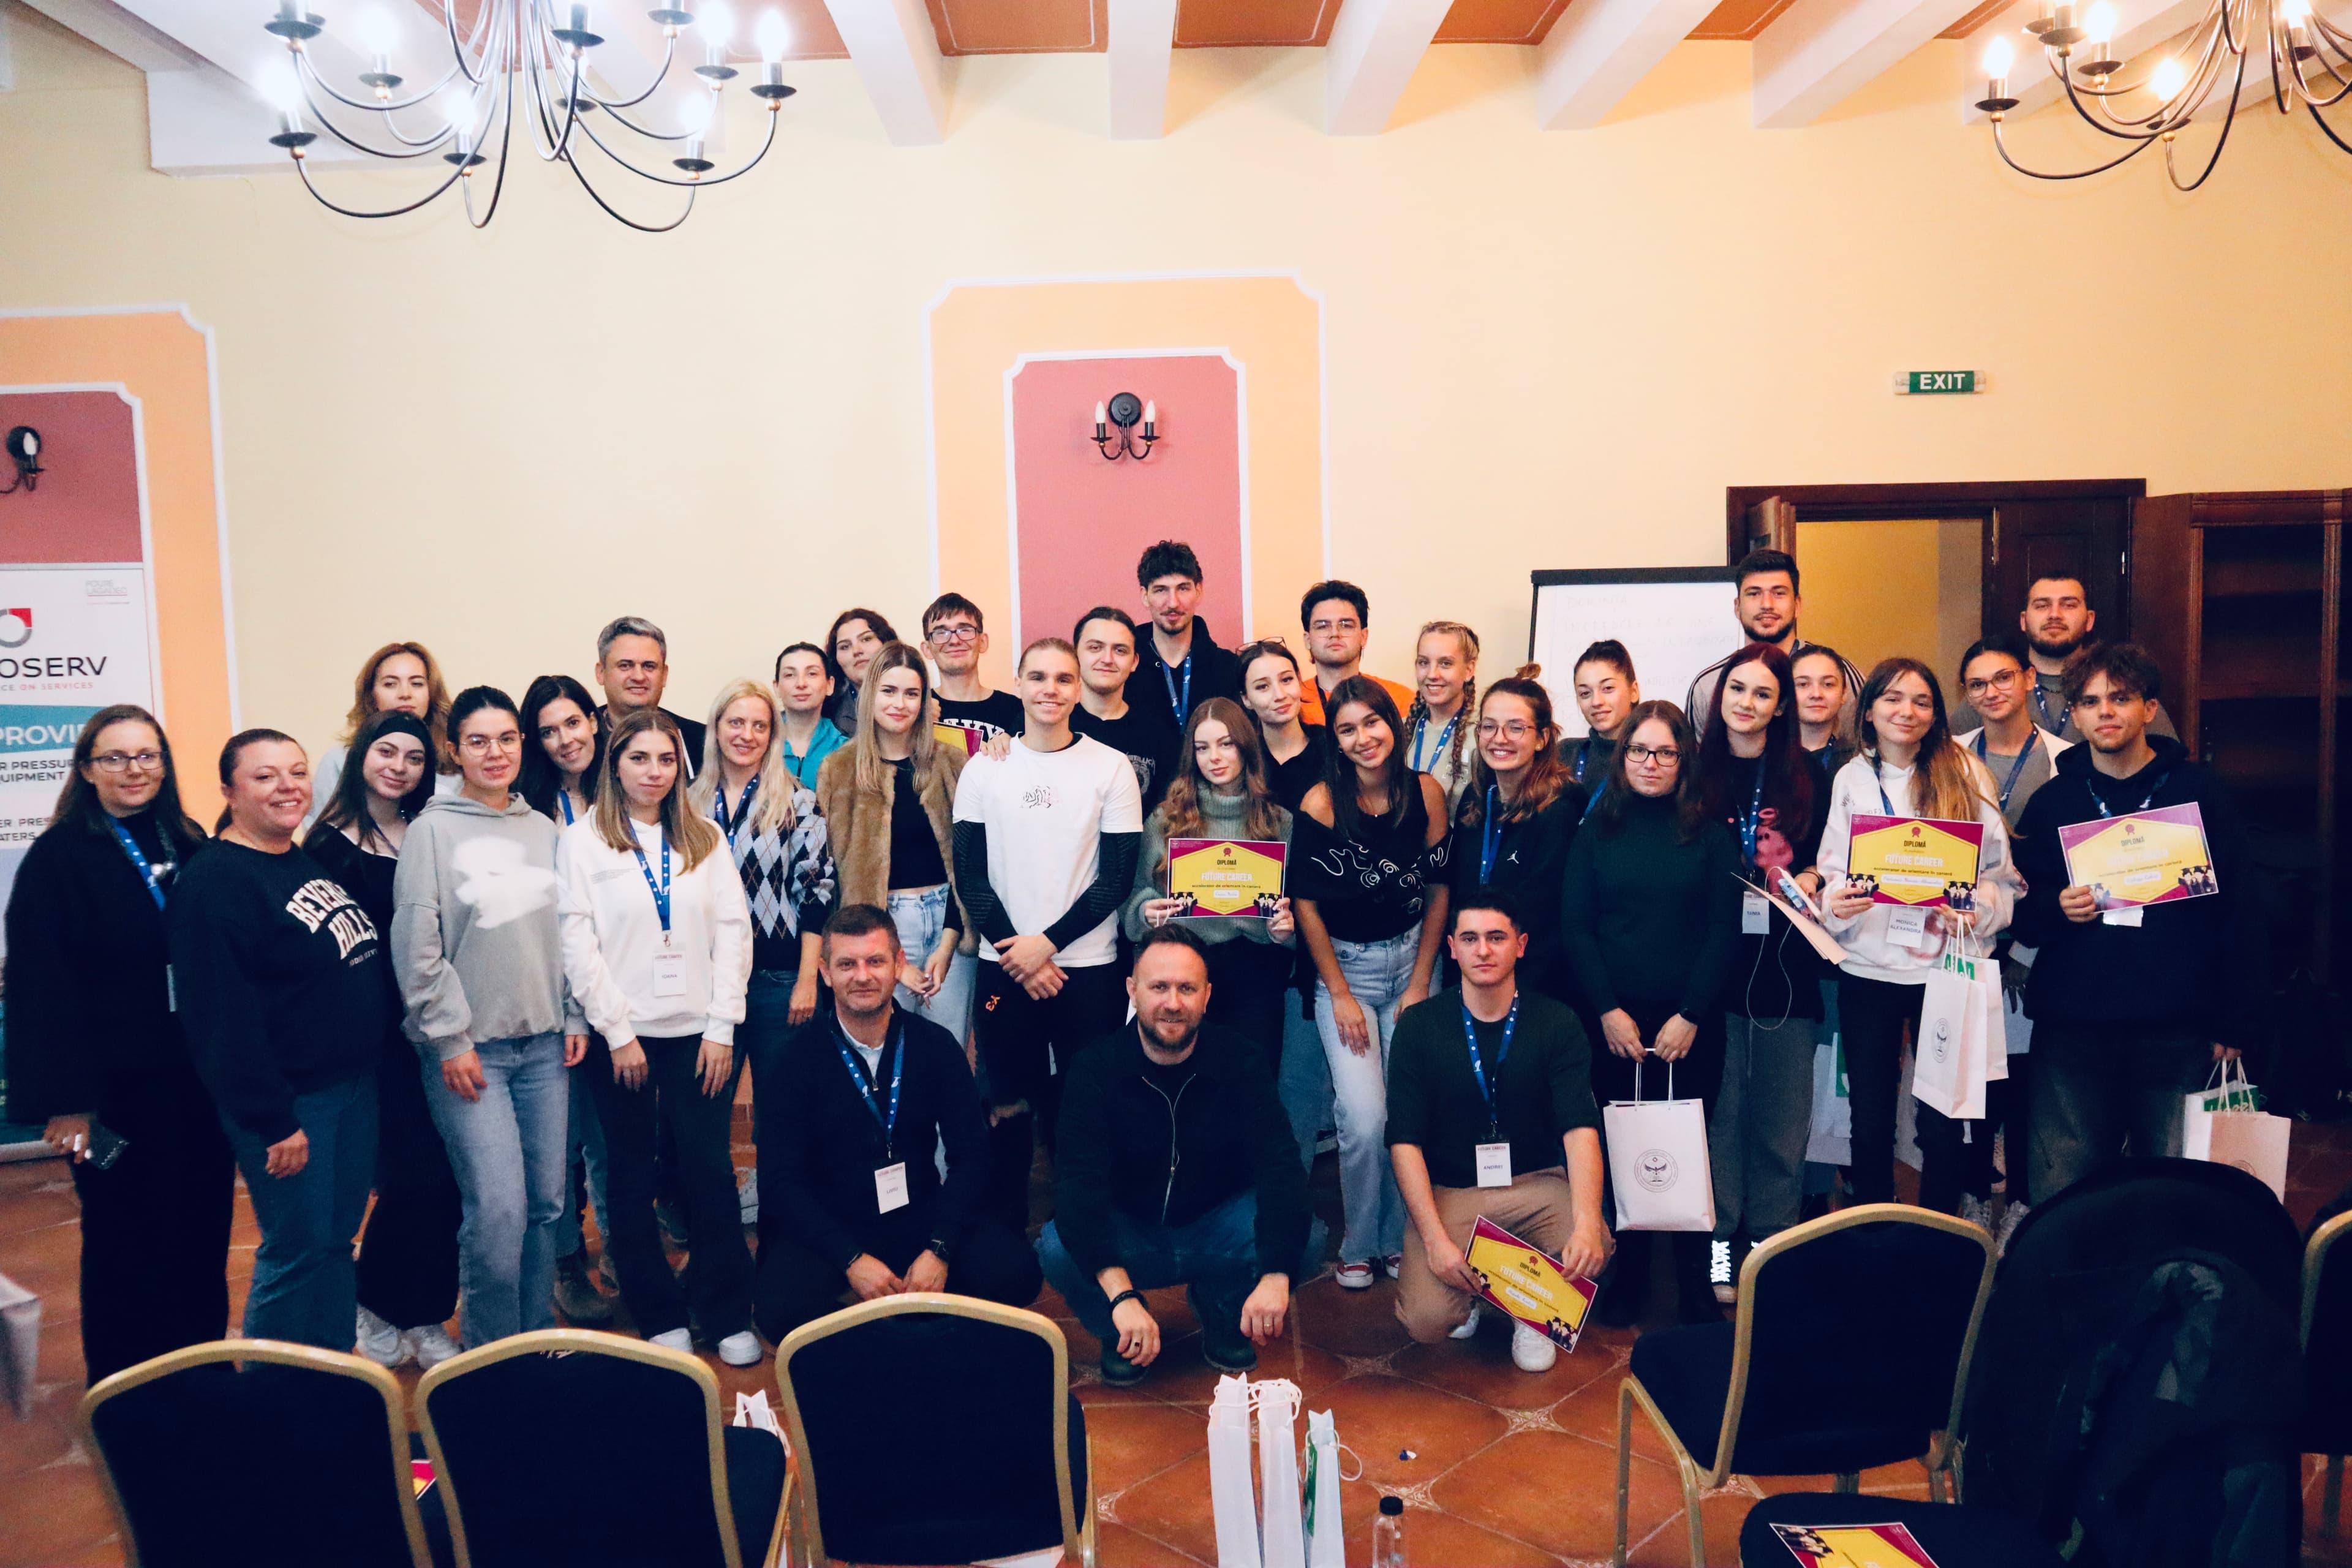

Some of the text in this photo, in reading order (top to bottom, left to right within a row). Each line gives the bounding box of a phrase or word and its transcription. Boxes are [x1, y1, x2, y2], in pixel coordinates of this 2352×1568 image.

[1920, 373, 1966, 390] EXIT
[1885, 853, 1944, 867] FUTURE CAREER
[1201, 872, 1253, 881] FUTURE CAREER
[328, 909, 378, 960] HILLS
[1890, 924, 1921, 933] ALEXANDRA
